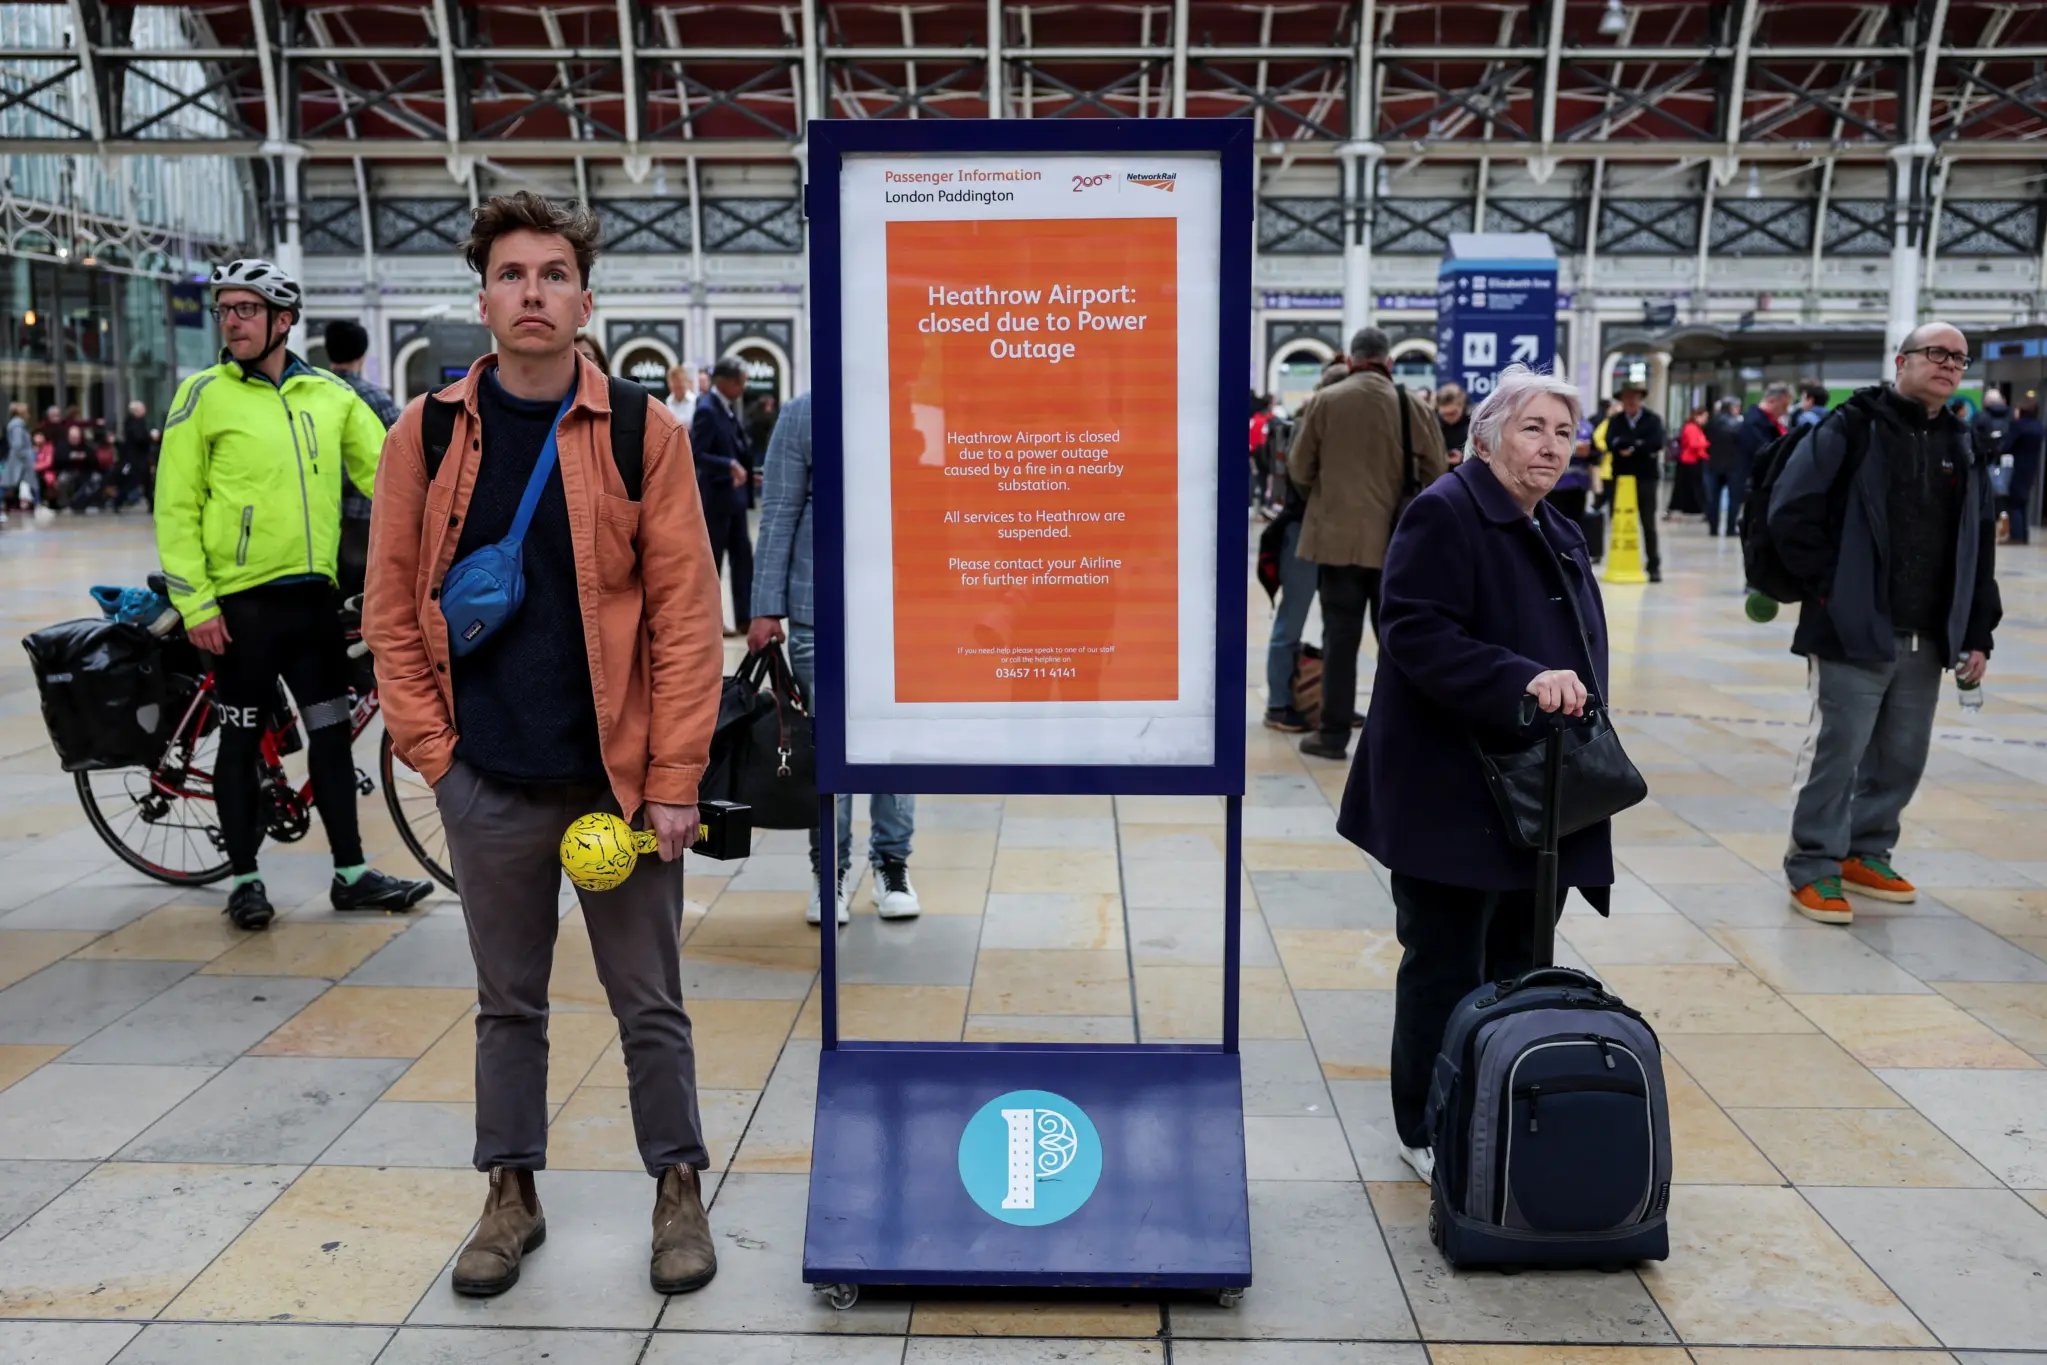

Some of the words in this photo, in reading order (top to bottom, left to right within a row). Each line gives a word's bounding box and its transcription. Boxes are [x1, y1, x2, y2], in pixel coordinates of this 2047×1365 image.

[886, 170, 953, 184] Passenger
[958, 168, 1041, 182] Information
[1072, 174, 1103, 192] 200
[1126, 172, 1177, 181] NetworkRail
[886, 190, 934, 203] London
[938, 189, 1014, 205] Paddington
[928, 285, 1041, 305] Heathrow
[1048, 284, 1136, 309] Airport:
[918, 312, 989, 332] closed
[996, 312, 1040, 331] due
[1045, 313, 1071, 331] to
[1078, 311, 1148, 330] Power
[989, 339, 1076, 363] Outage
[947, 432, 1012, 443] Heathrow
[1015, 432, 1062, 445] Airport
[1065, 432, 1076, 442] is
[1078, 430, 1120, 442] closed
[959, 448, 985, 459] due
[987, 449, 1002, 459] to
[1005, 451, 1014, 459] a
[1017, 450, 1058, 462] power
[1061, 448, 1109, 461] outage
[943, 464, 990, 475] caused
[993, 464, 1010, 478] by
[1013, 466, 1022, 475] a
[1025, 463, 1047, 474] fire
[1050, 464, 1062, 474] in
[1065, 466, 1075, 475] a
[1078, 462, 1124, 476] nearby
[997, 478, 1070, 491] substation.
[943, 511, 960, 523] All
[963, 512, 1015, 522] services
[1017, 512, 1033, 522] to
[1035, 510, 1101, 521] Heathrow
[1103, 513, 1126, 521] are
[997, 526, 1071, 540] suspended.
[948, 558, 991, 569] Please
[993, 559, 1044, 569] contact
[1046, 560, 1076, 573] your
[1079, 557, 1122, 568] Airline
[961, 574, 980, 585] for
[982, 573, 1028, 585] further
[1032, 572, 1109, 584] information
[996, 646, 1011, 655] help
[1012, 646, 1033, 654] please
[1035, 646, 1054, 654] speak
[1099, 645, 1116, 653] staff
[995, 669, 1030, 677] 03457
[1033, 669, 1046, 677] 11
[1049, 668, 1076, 677] 4141
